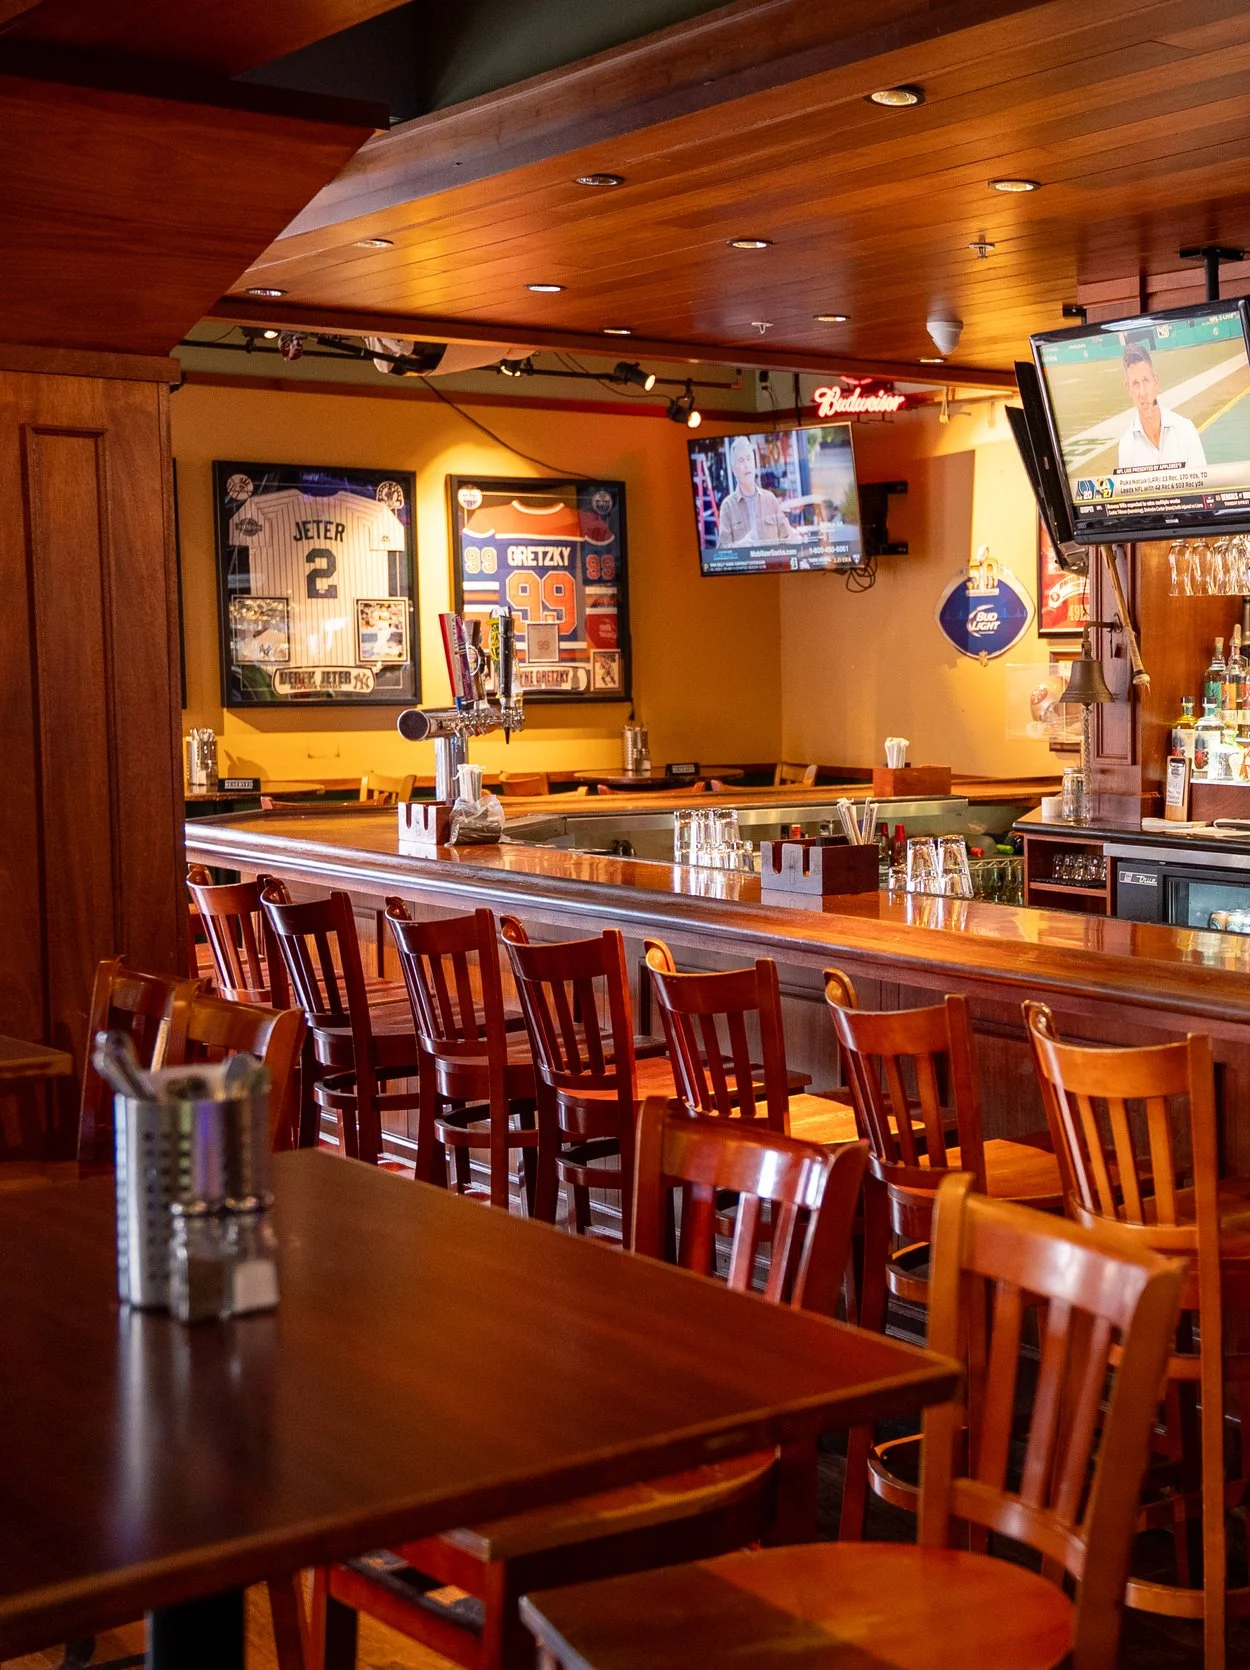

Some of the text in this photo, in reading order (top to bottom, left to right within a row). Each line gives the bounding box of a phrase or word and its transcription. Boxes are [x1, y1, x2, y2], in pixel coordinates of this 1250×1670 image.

[814, 386, 905, 418] Budweiser
[293, 520, 345, 542] JETER
[464, 546, 498, 574] 99
[507, 545, 571, 567] GRETZKY
[586, 554, 615, 580] 99
[306, 548, 338, 598] 2
[505, 570, 578, 636] 99
[972, 621, 1000, 631] LIGHT
[975, 612, 998, 622] BUD
[279, 671, 351, 685] DEREK JETER
[536, 670, 570, 684] GRETZKY
